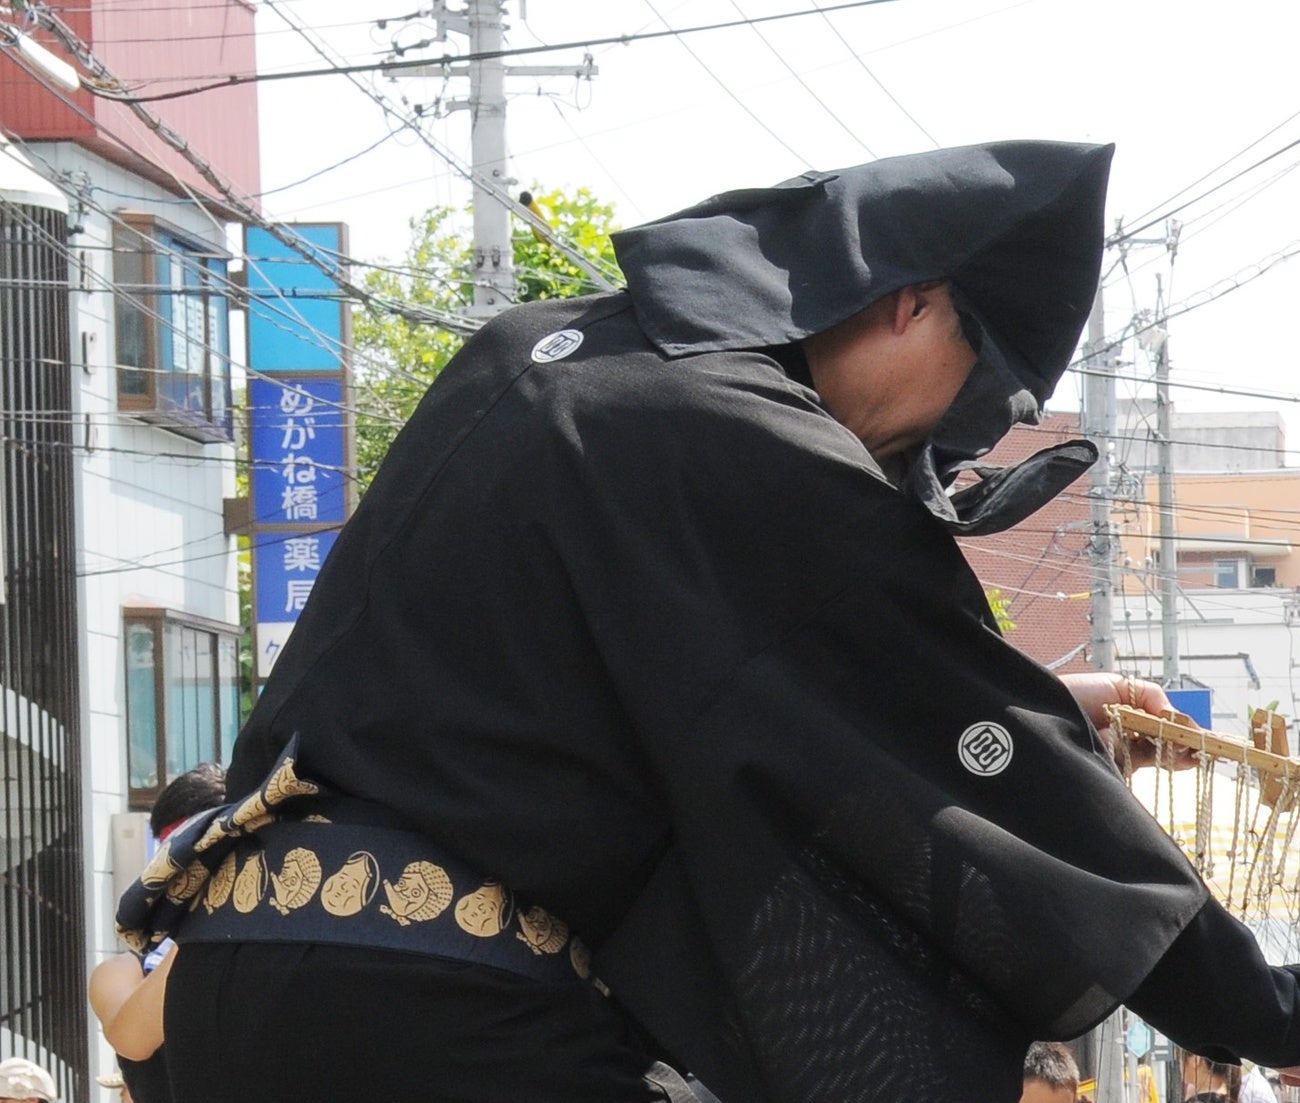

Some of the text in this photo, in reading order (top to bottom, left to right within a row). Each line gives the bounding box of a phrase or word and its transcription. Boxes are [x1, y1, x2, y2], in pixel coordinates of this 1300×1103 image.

[278, 383, 321, 614] めがね橋薬局
